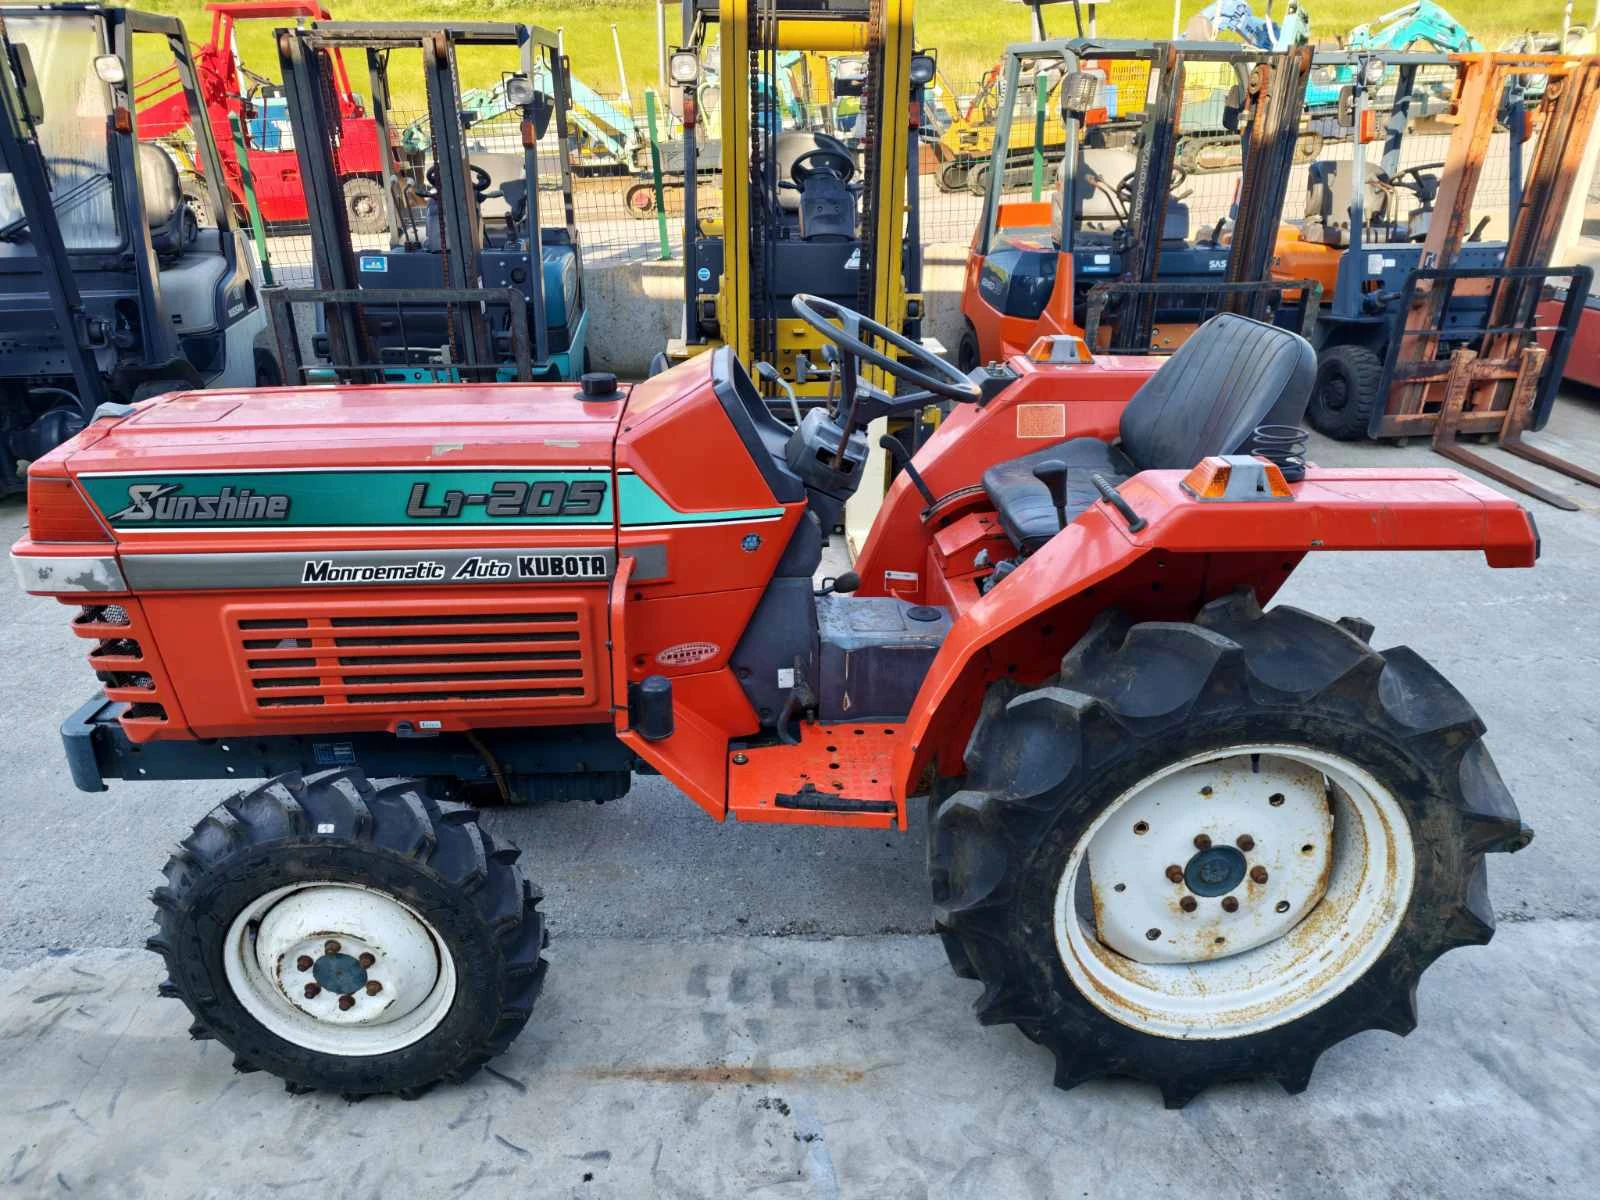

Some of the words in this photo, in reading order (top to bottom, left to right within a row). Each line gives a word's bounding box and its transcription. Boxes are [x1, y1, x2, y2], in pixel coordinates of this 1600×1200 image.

[107, 483, 290, 521] Sunshine
[407, 480, 607, 518] L1-205
[302, 560, 446, 583] Monroematic
[452, 557, 512, 581] Auto
[517, 555, 607, 578] KUBOTA
